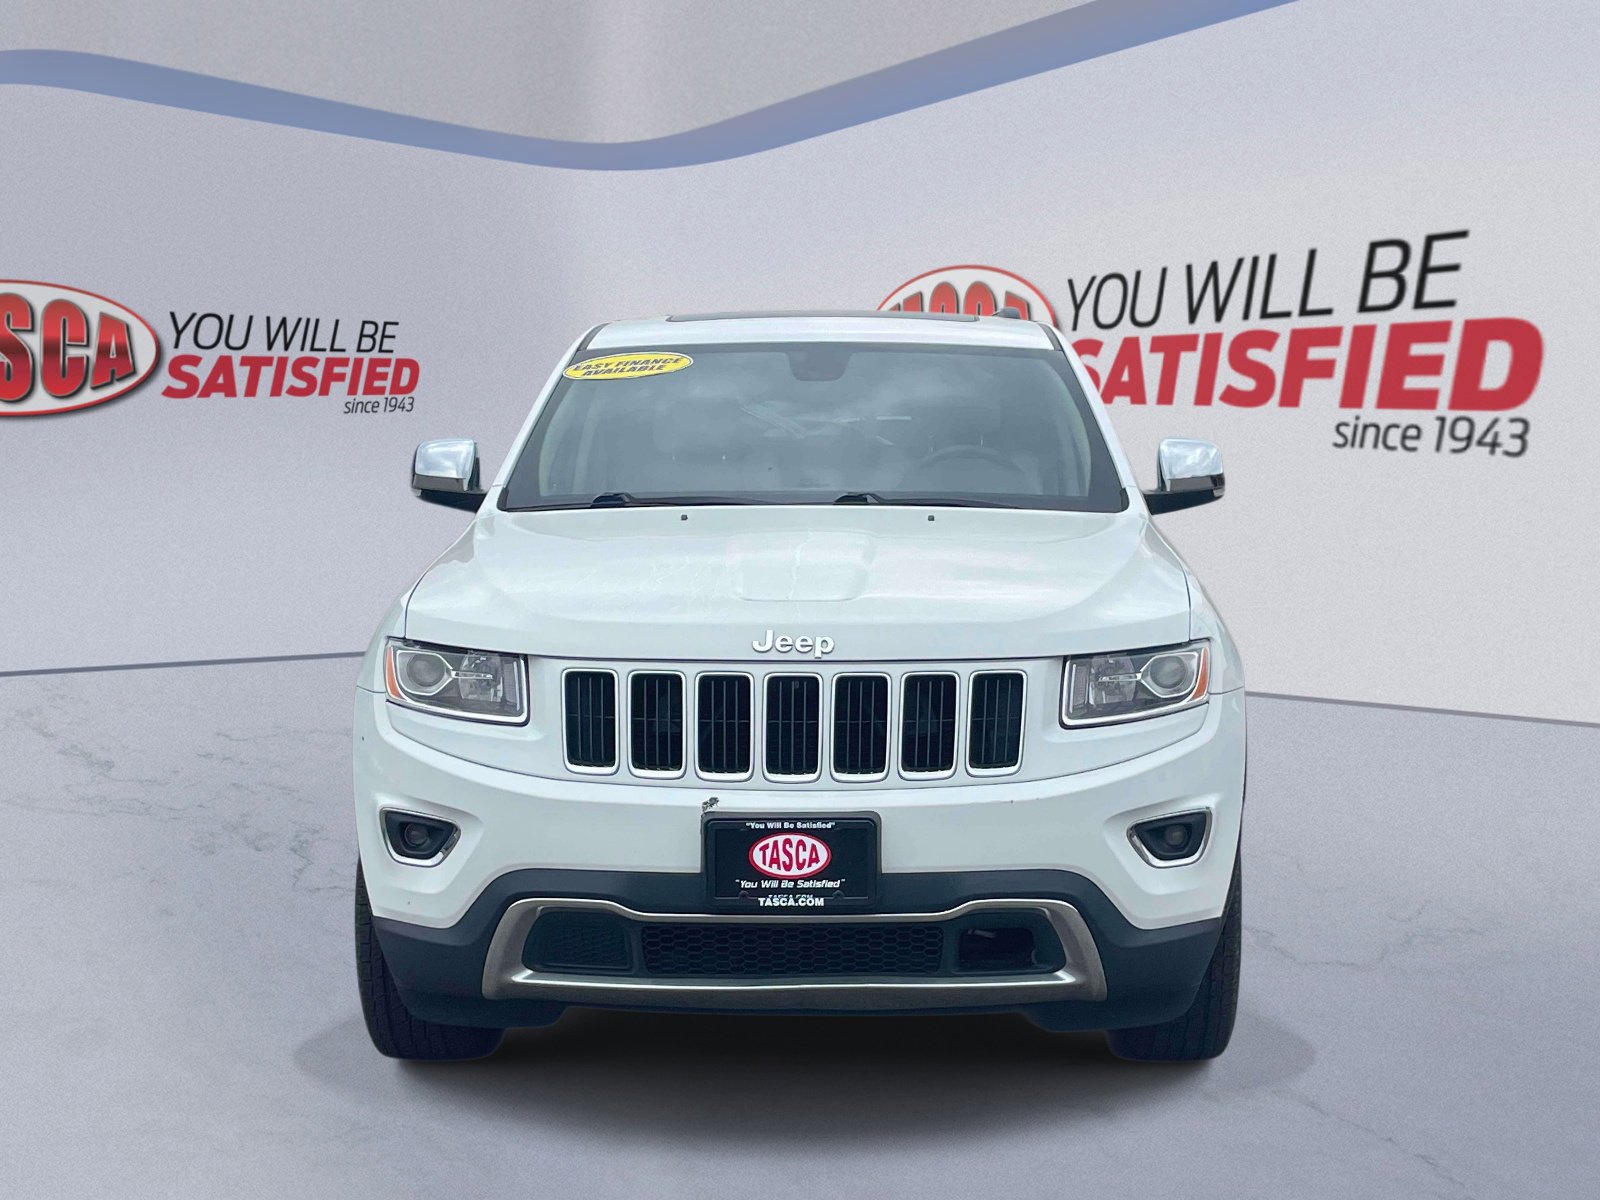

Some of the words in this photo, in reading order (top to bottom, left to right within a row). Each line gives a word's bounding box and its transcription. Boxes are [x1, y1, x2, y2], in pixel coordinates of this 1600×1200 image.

[1066, 266, 1169, 333] YOU
[1185, 248, 1334, 325] WILL
[1357, 229, 1471, 315] BE
[169, 311, 254, 350] YOU
[265, 315, 347, 353] WILL
[355, 320, 400, 354] BE
[161, 353, 421, 399] SATISFIED
[573, 362, 611, 371] EASY
[614, 358, 682, 367] FINANCE
[582, 364, 667, 376] AVAILABLE
[344, 396, 381, 415] since
[384, 396, 415, 413] 1943
[1332, 414, 1422, 453] since
[1435, 416, 1530, 458] 1943
[752, 629, 835, 659] Jeep
[766, 821, 782, 829] Will
[783, 821, 795, 829] Be
[758, 837, 821, 872] TASCA
[760, 879, 779, 889] Will
[780, 879, 795, 889] Be
[757, 897, 825, 907] TASCA.COM
